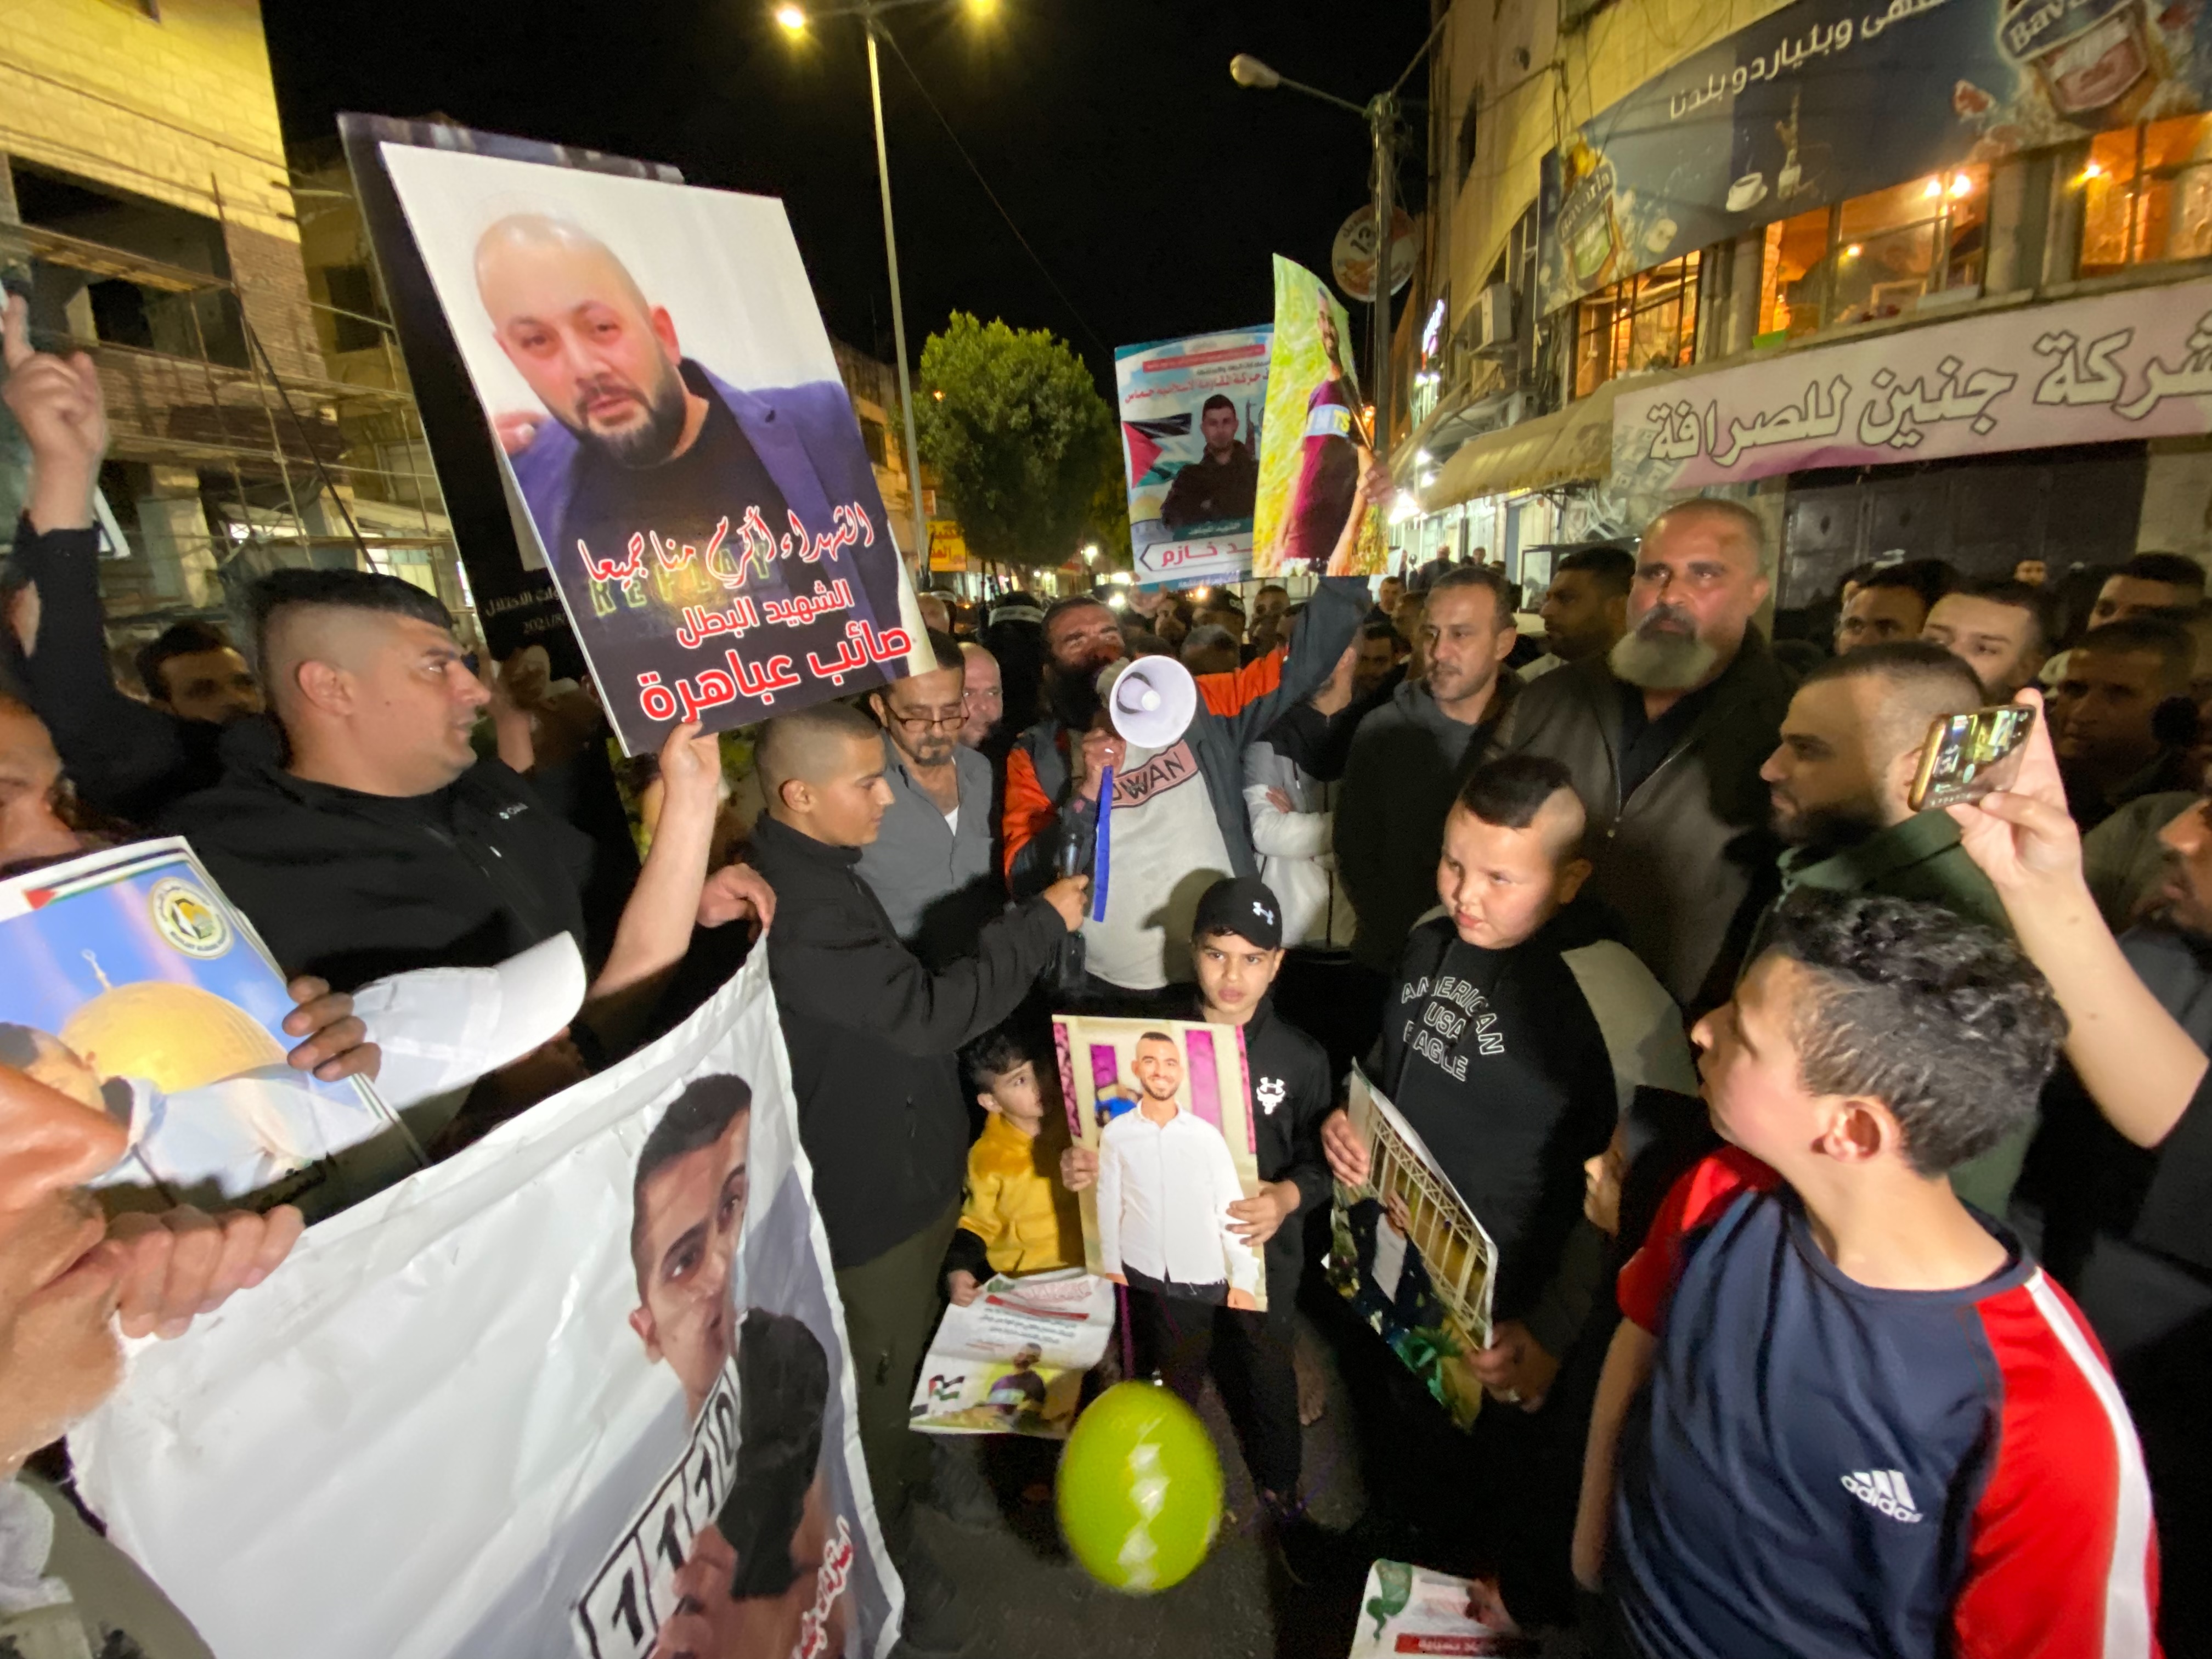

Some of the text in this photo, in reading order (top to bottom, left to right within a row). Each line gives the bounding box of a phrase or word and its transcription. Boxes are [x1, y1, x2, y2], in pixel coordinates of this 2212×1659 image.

[1731, 18, 1853, 95] وبلياردو
[1670, 73, 1726, 120] بلدنا
[1647, 374, 1852, 468] للصرافة
[1858, 355, 2019, 450] جنين
[577, 532, 649, 591] جميعا
[650, 530, 696, 571] منا
[781, 501, 874, 562] الشهداء
[676, 578, 854, 648] الشهيد البطل
[637, 620, 913, 723] صائب عباهرة
[1401, 976, 1505, 1055] AMERICAN
[1424, 1001, 1466, 1039] USA
[1403, 1019, 1469, 1082] EAGLE
[1841, 1475, 1923, 1523] adidas
